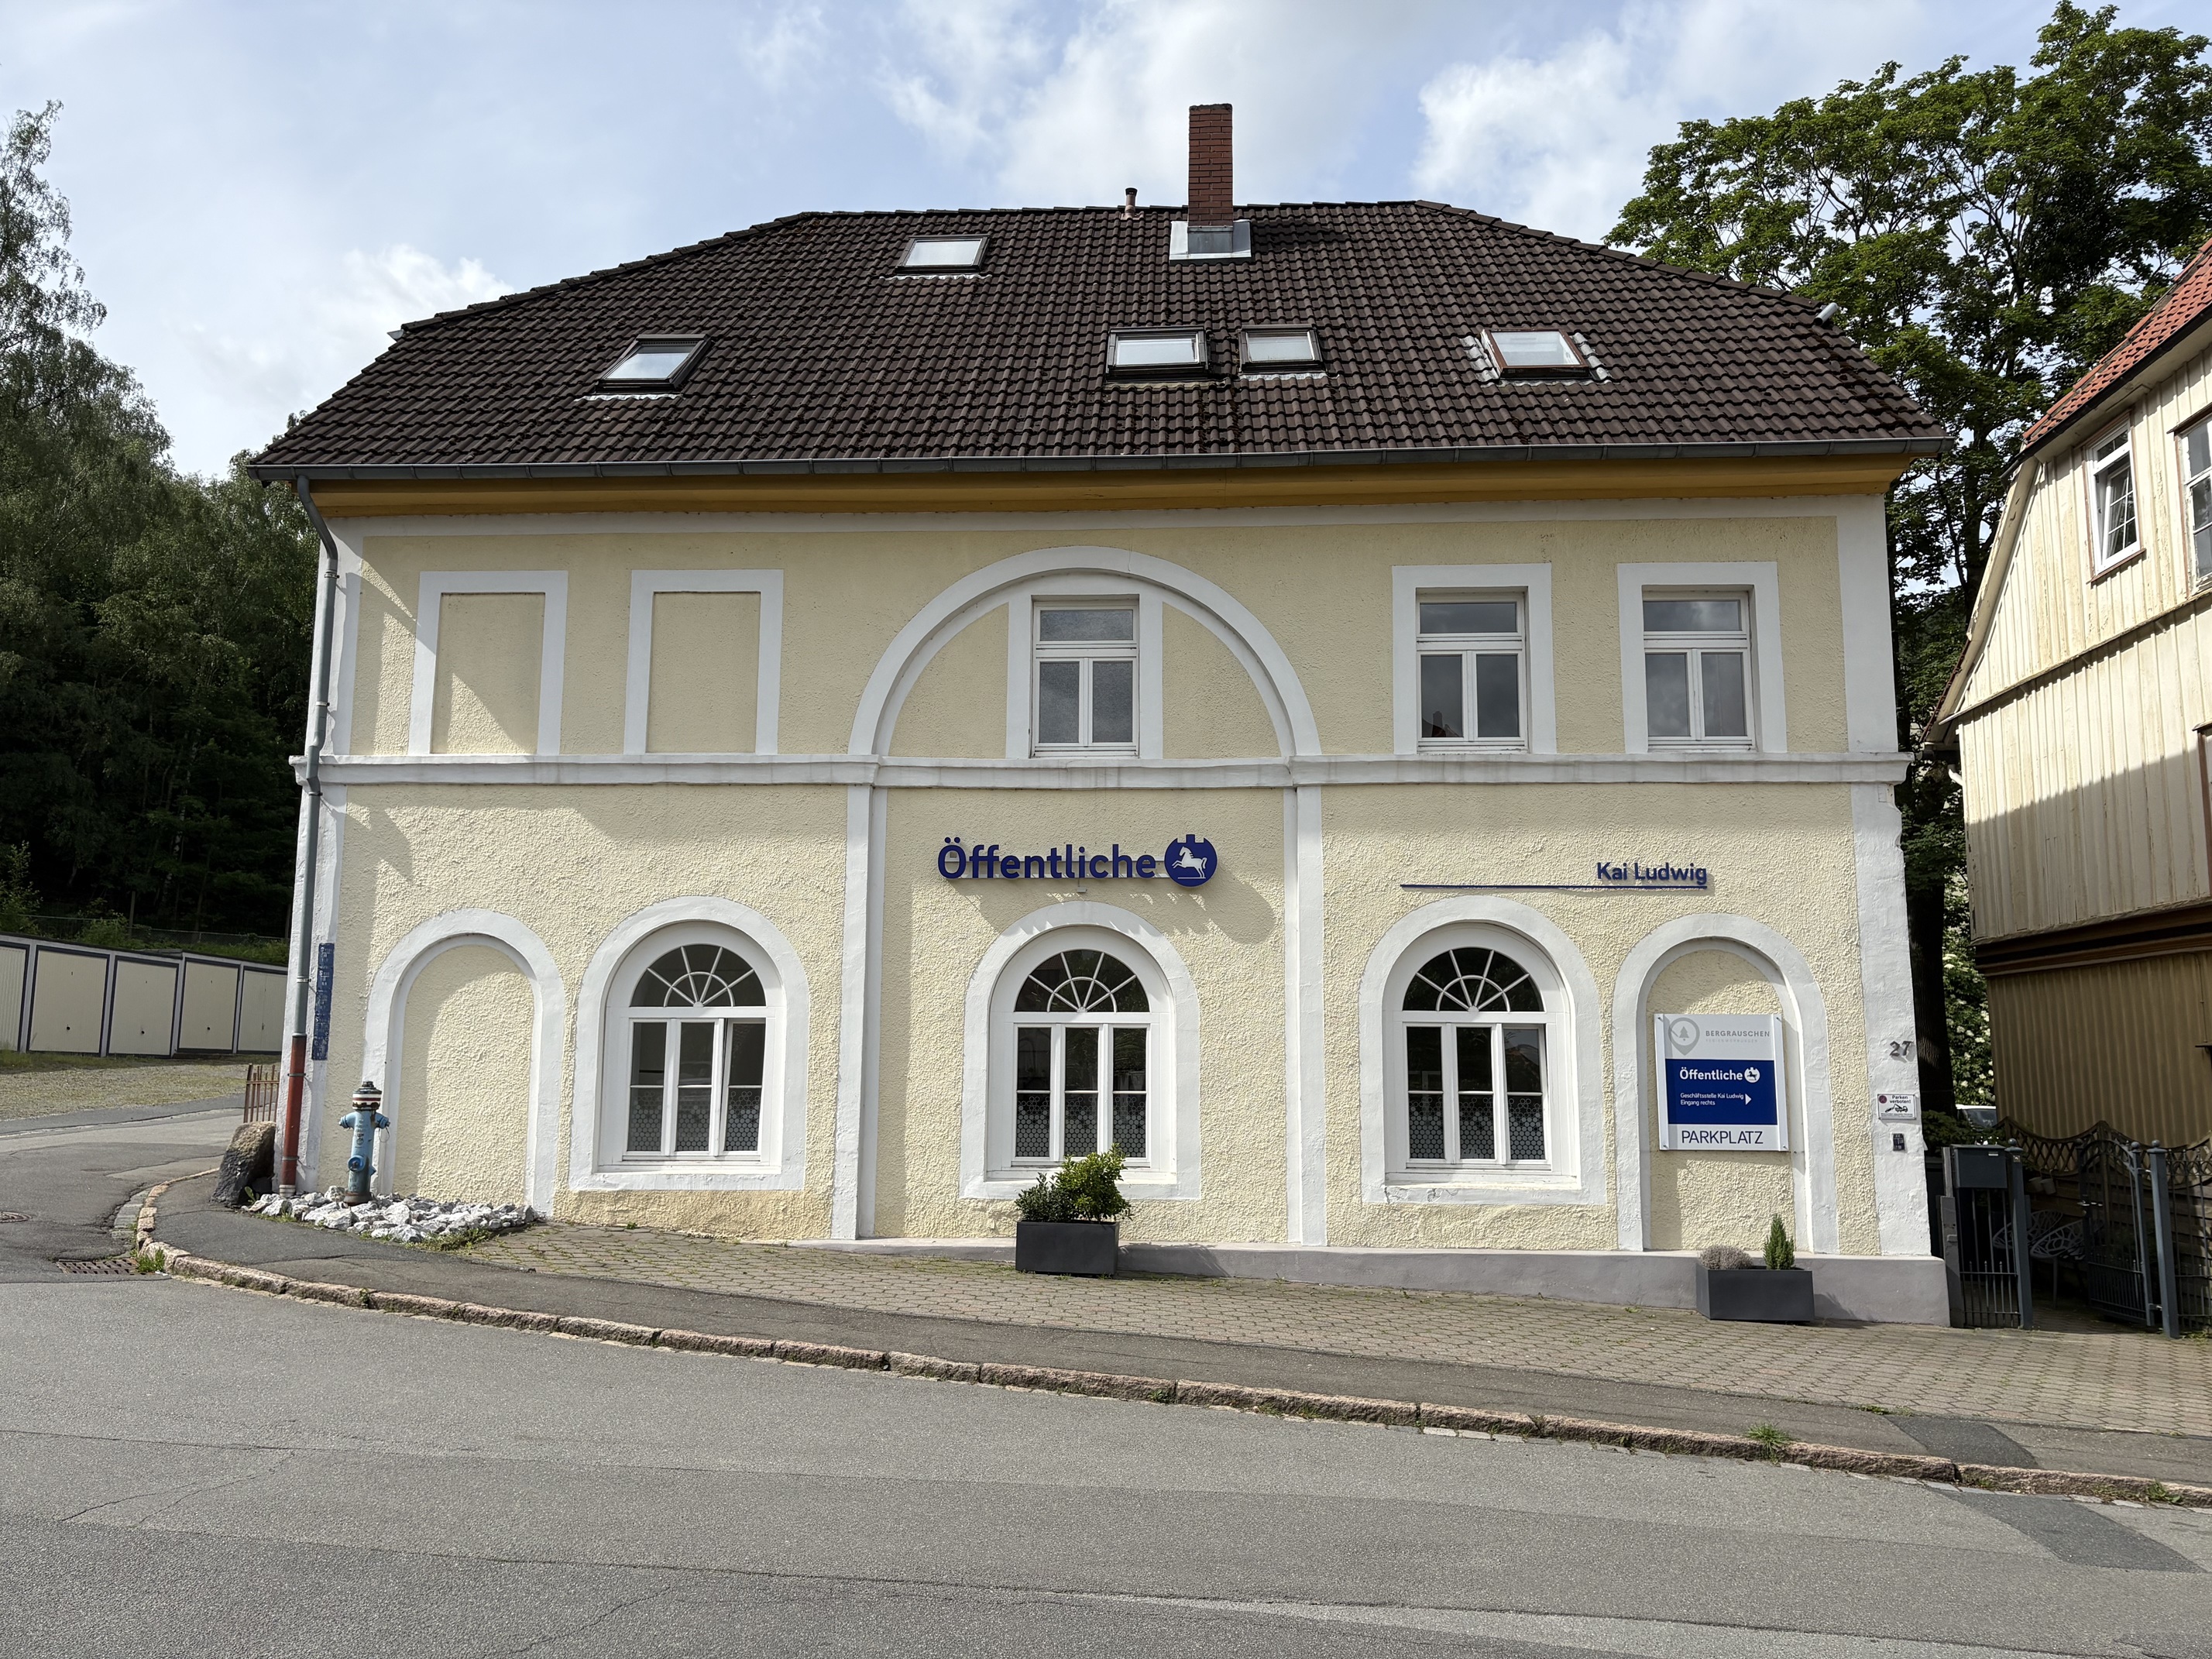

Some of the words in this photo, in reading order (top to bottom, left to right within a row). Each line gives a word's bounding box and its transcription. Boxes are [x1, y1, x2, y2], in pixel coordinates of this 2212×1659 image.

[937, 836, 1157, 879] Öffentliche
[1597, 862, 1627, 881] Kai
[1634, 862, 1707, 885] Ludwig
[1889, 1040, 1914, 1056] 27
[1679, 1066, 1743, 1080] Öffentliche
[1681, 1131, 1764, 1145] PARKPLATZ
